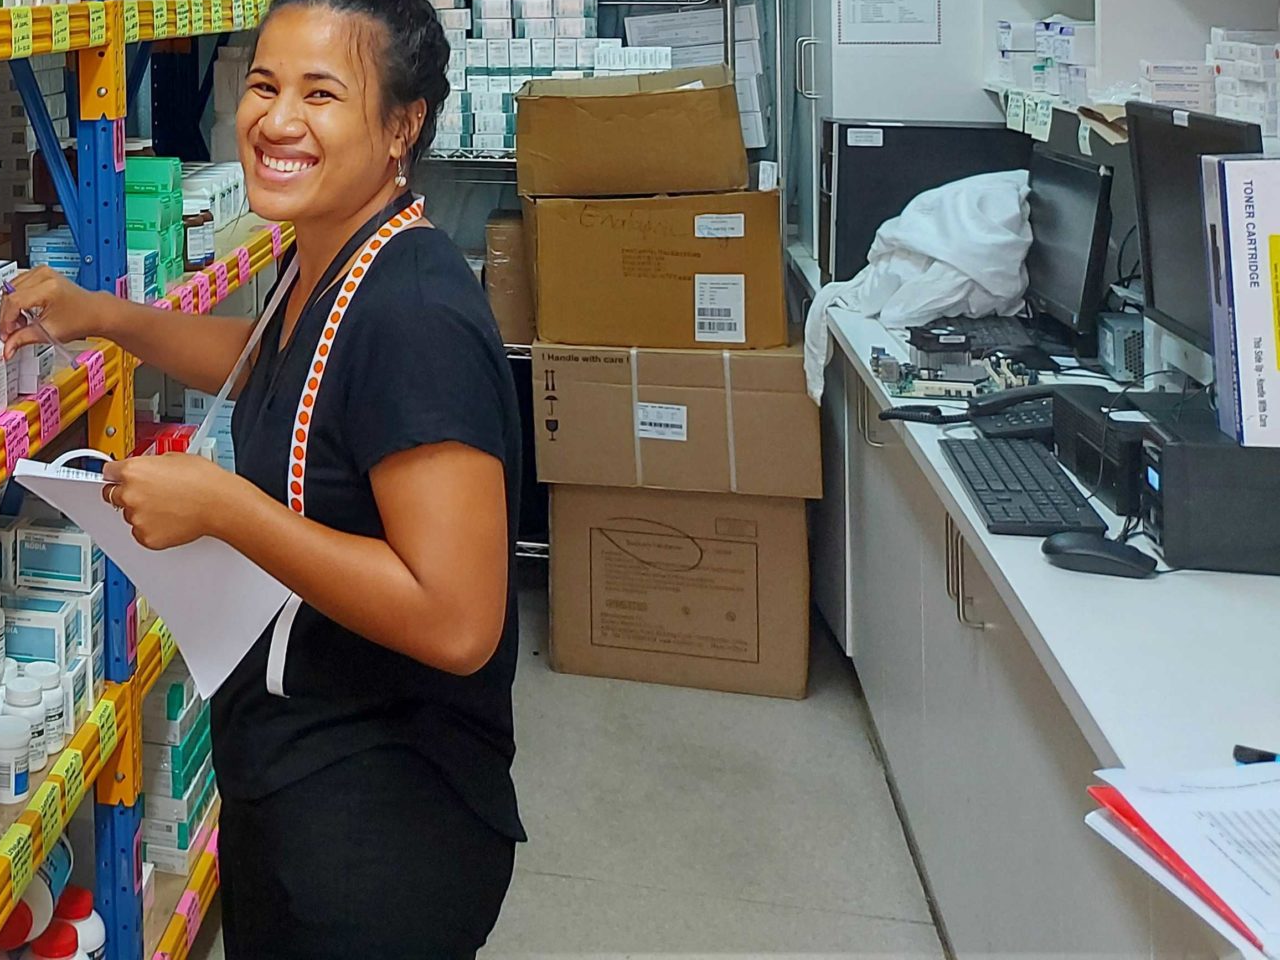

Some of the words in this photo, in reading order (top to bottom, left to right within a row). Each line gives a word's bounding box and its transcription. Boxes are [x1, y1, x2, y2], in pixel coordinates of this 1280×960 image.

[1243, 180, 1254, 212] TONER
[1246, 215, 1260, 288] CARTRIDGE
[547, 353, 579, 363] Handle
[582, 355, 601, 363] with
[604, 357, 623, 365] care
